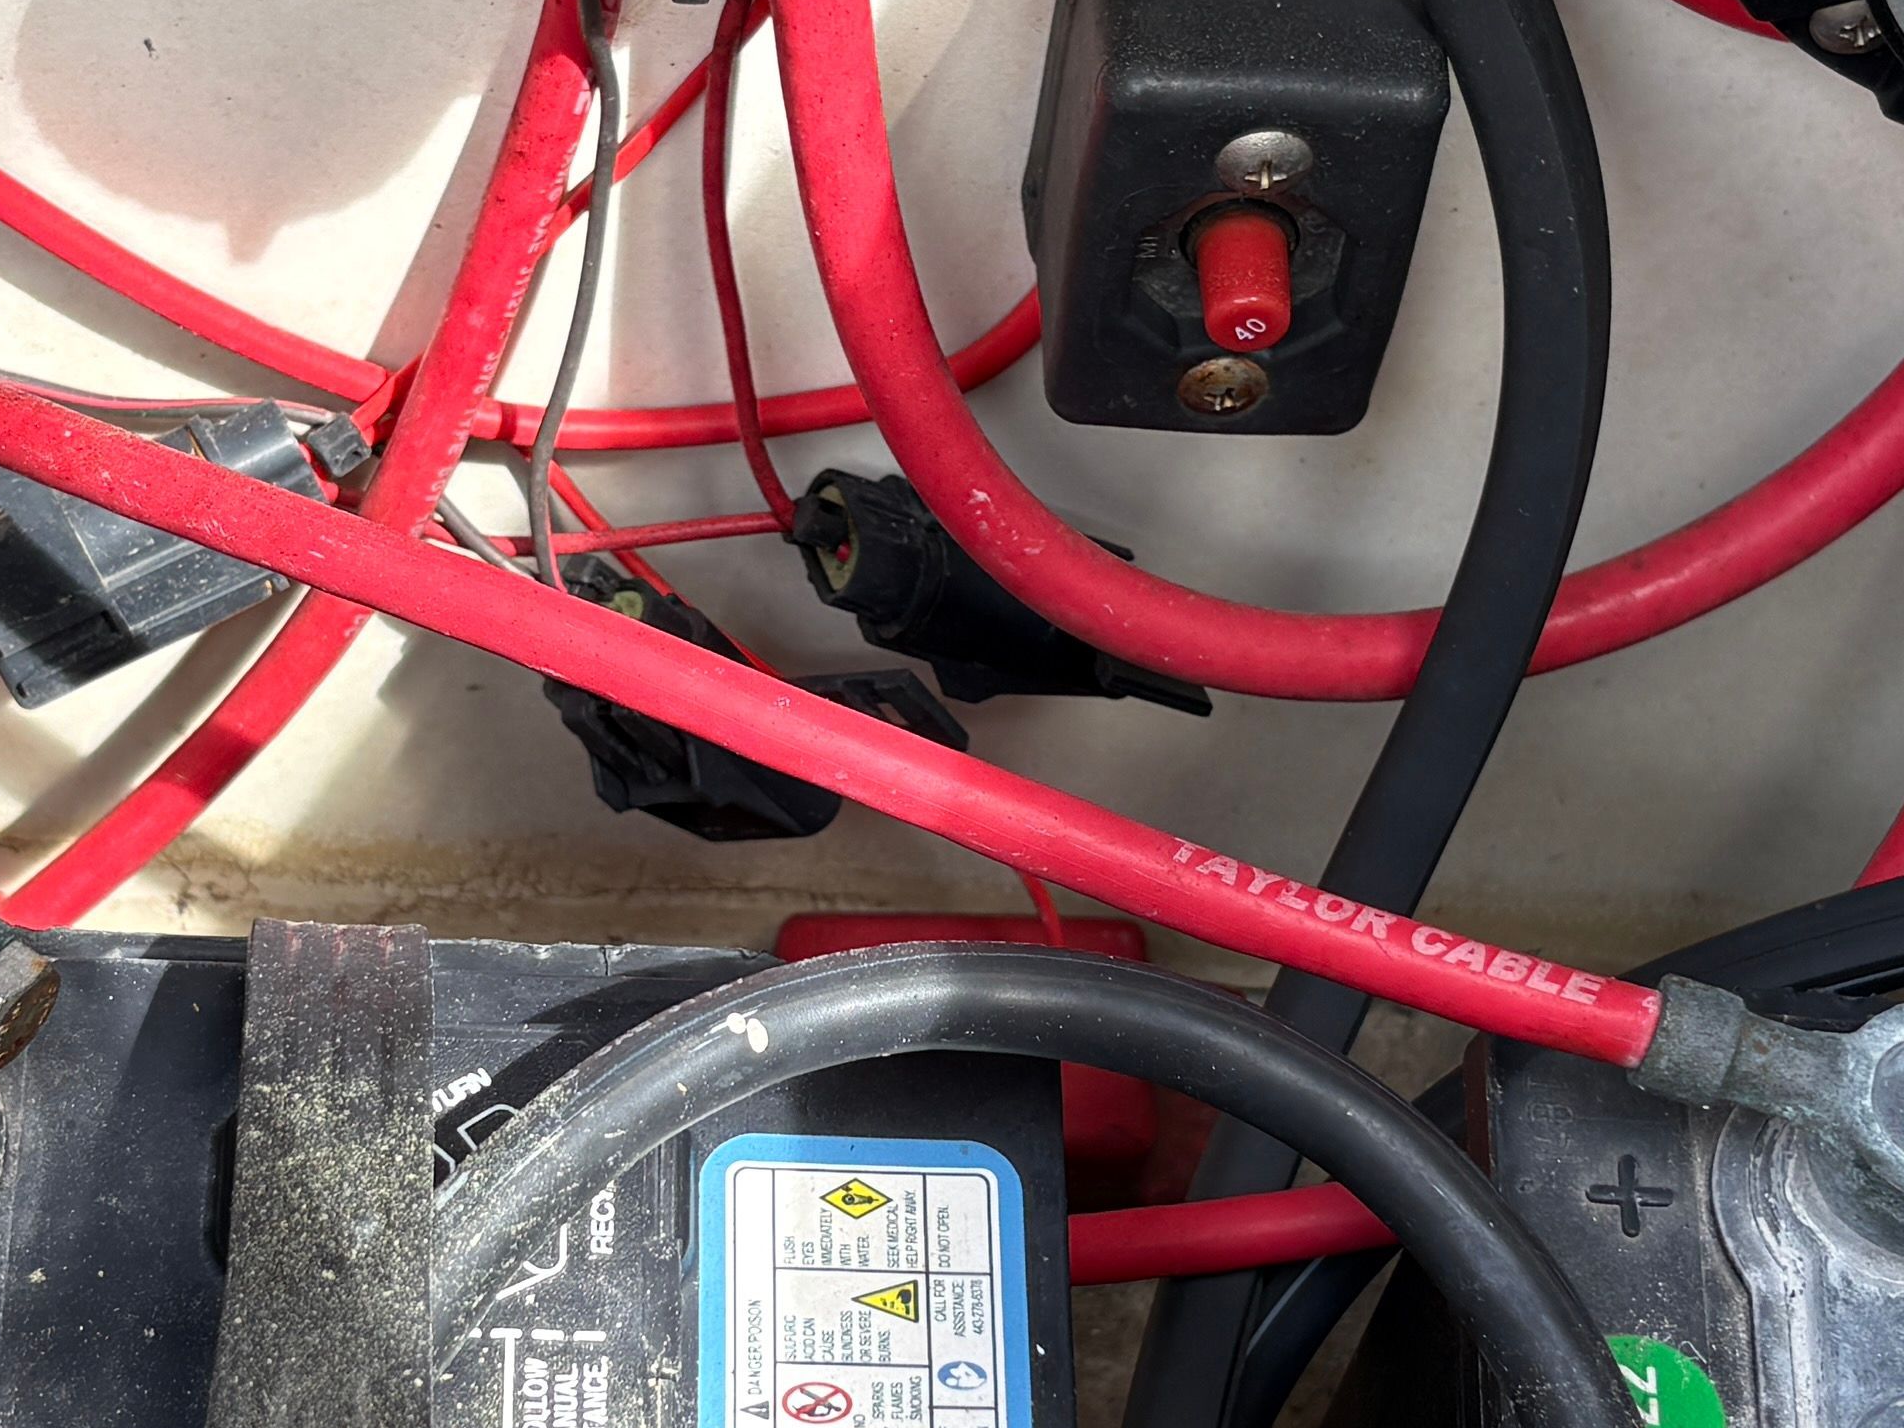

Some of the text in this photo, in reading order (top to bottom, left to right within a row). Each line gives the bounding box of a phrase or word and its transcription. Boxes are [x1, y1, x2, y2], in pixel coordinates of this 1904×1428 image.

[1234, 318, 1266, 340] 40
[1172, 839, 1605, 1005] TAYLOR CABLE
[432, 1066, 492, 1114] TURN
